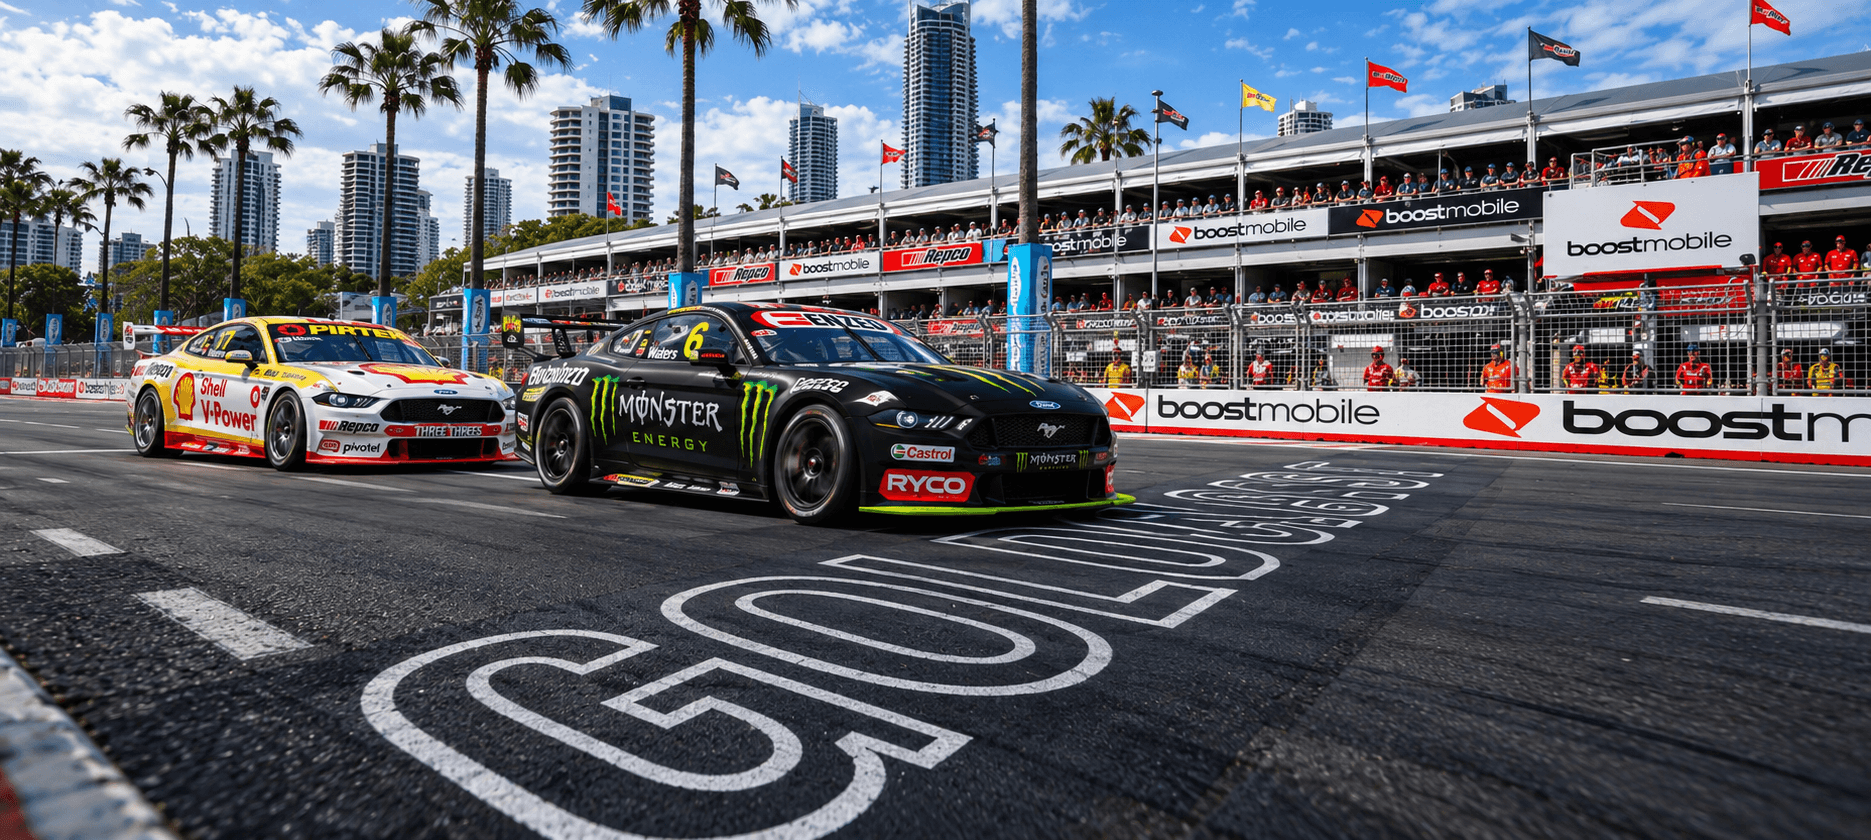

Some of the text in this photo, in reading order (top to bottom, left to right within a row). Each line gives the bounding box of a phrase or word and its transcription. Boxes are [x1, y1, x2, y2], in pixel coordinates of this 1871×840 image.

[1827, 152, 1871, 178] Re
[1386, 197, 1520, 224] boostmobile
[1194, 217, 1307, 240] boostmobile
[1052, 232, 1127, 253] ostmobile
[1567, 231, 1732, 257] boostmobile
[803, 258, 870, 275] boostmobile
[924, 247, 971, 266] Repco
[803, 312, 888, 331] ENZED
[684, 321, 710, 359] 6
[201, 377, 227, 398] Shell
[1158, 394, 1380, 425] boostmobile
[338, 420, 380, 434] Repco
[414, 426, 447, 437] THREE
[342, 442, 381, 454] pivotel
[632, 430, 708, 453] ENERGY
[906, 446, 952, 461] Castrol
[887, 473, 966, 495] RYCO
